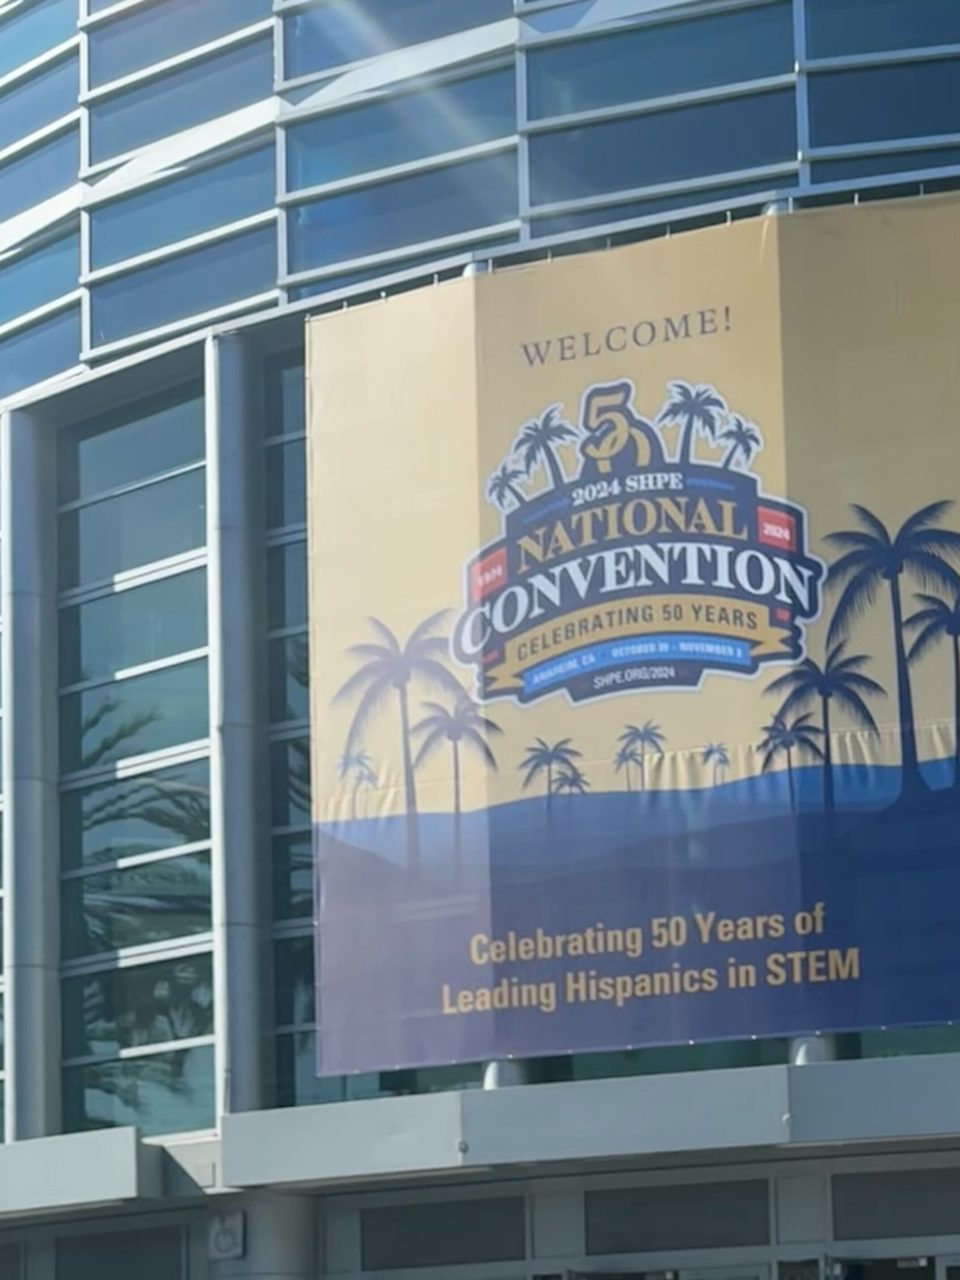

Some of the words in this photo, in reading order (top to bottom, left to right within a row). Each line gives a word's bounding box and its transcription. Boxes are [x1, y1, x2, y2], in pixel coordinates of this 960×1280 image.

[520, 305, 732, 367] WELCOME!
[572, 478, 621, 505] 2024
[625, 472, 684, 492] SHPE
[517, 497, 748, 575] NATIONAL
[461, 542, 814, 654] CONVENTION
[517, 605, 653, 661] CELEBRATING
[662, 603, 683, 621] 50
[691, 604, 758, 630] YEARS
[593, 665, 676, 690] SHPE.ORG/2024
[469, 921, 642, 966] Celebrating
[651, 915, 687, 948] 50
[694, 911, 785, 943] Years
[795, 902, 826, 935] of
[442, 974, 556, 1015] Leading
[566, 962, 718, 1006] Hispanics
[728, 958, 757, 989] in
[766, 947, 860, 986] STEM
